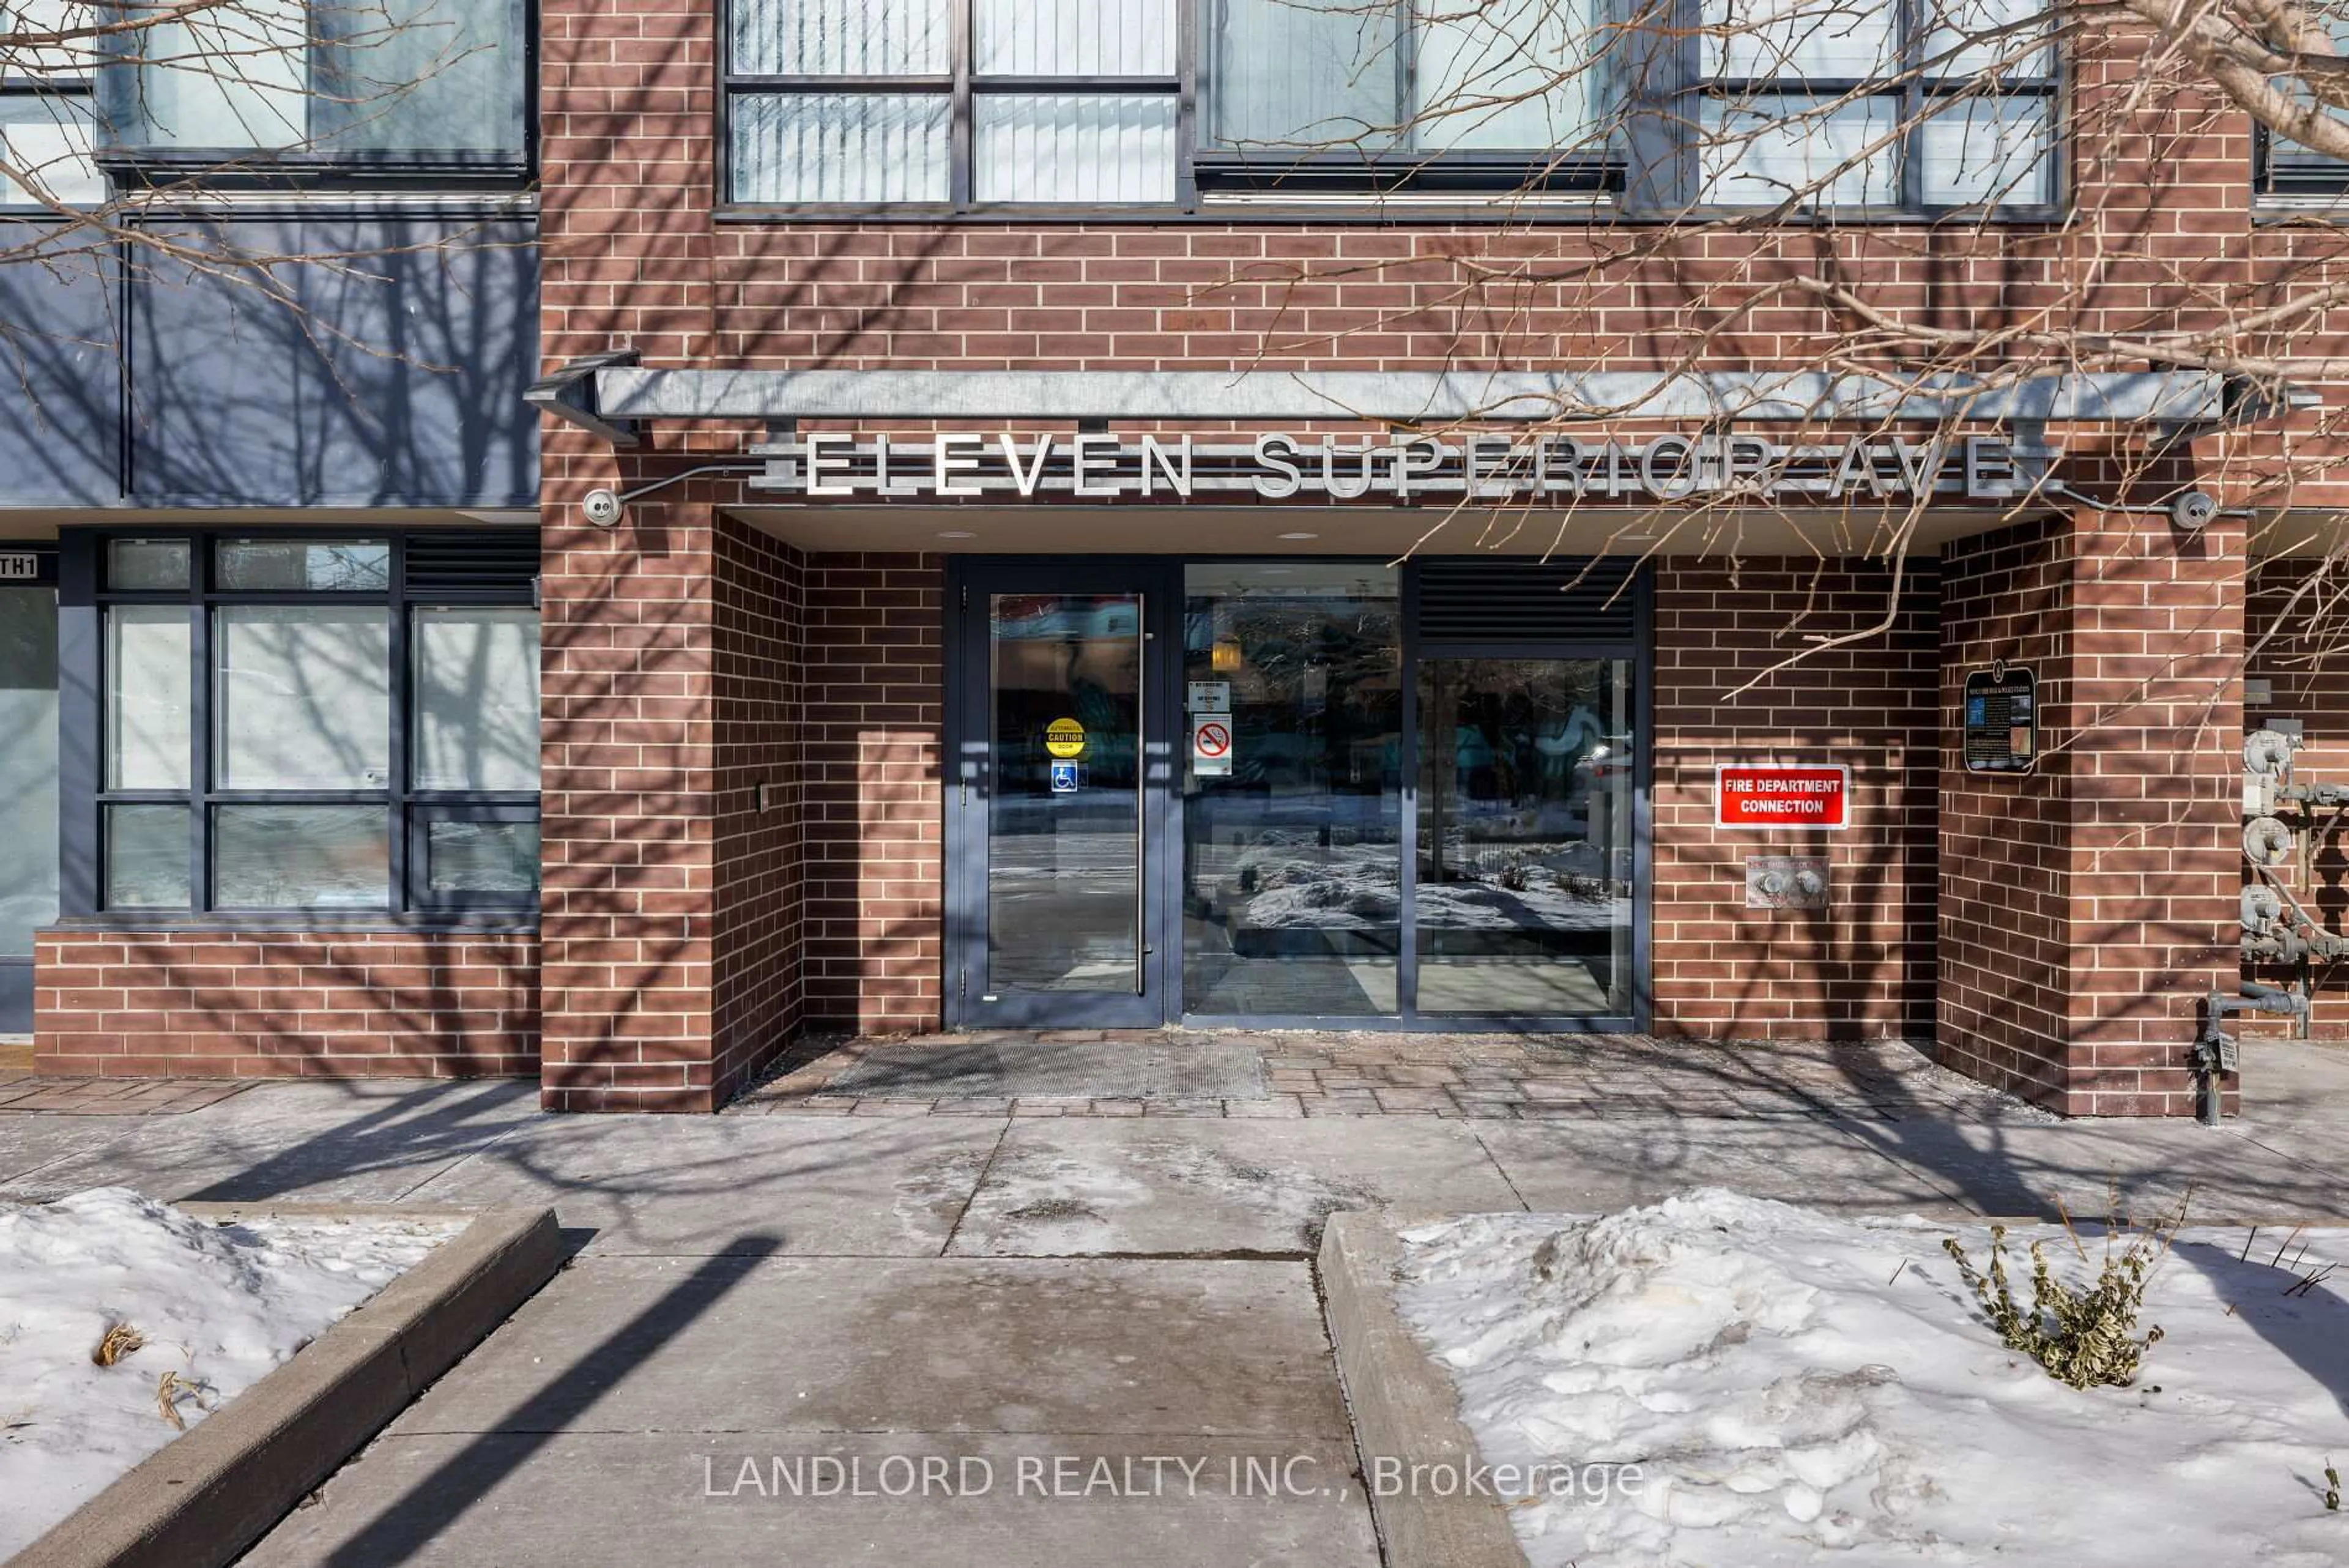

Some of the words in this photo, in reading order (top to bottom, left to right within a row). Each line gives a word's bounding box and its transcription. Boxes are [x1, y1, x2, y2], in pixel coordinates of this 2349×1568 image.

[806, 433, 1192, 496] ELEVEN
[1250, 432, 1776, 499] SUPERIOR
[1829, 436, 2014, 498] AVE
[0, 557, 35, 574] TH1
[1048, 733, 1083, 741] CAUTION
[1725, 779, 1753, 792] FIRE
[1756, 779, 1841, 792] DEPARTMENT
[1740, 800, 1824, 813] CONNECTION
